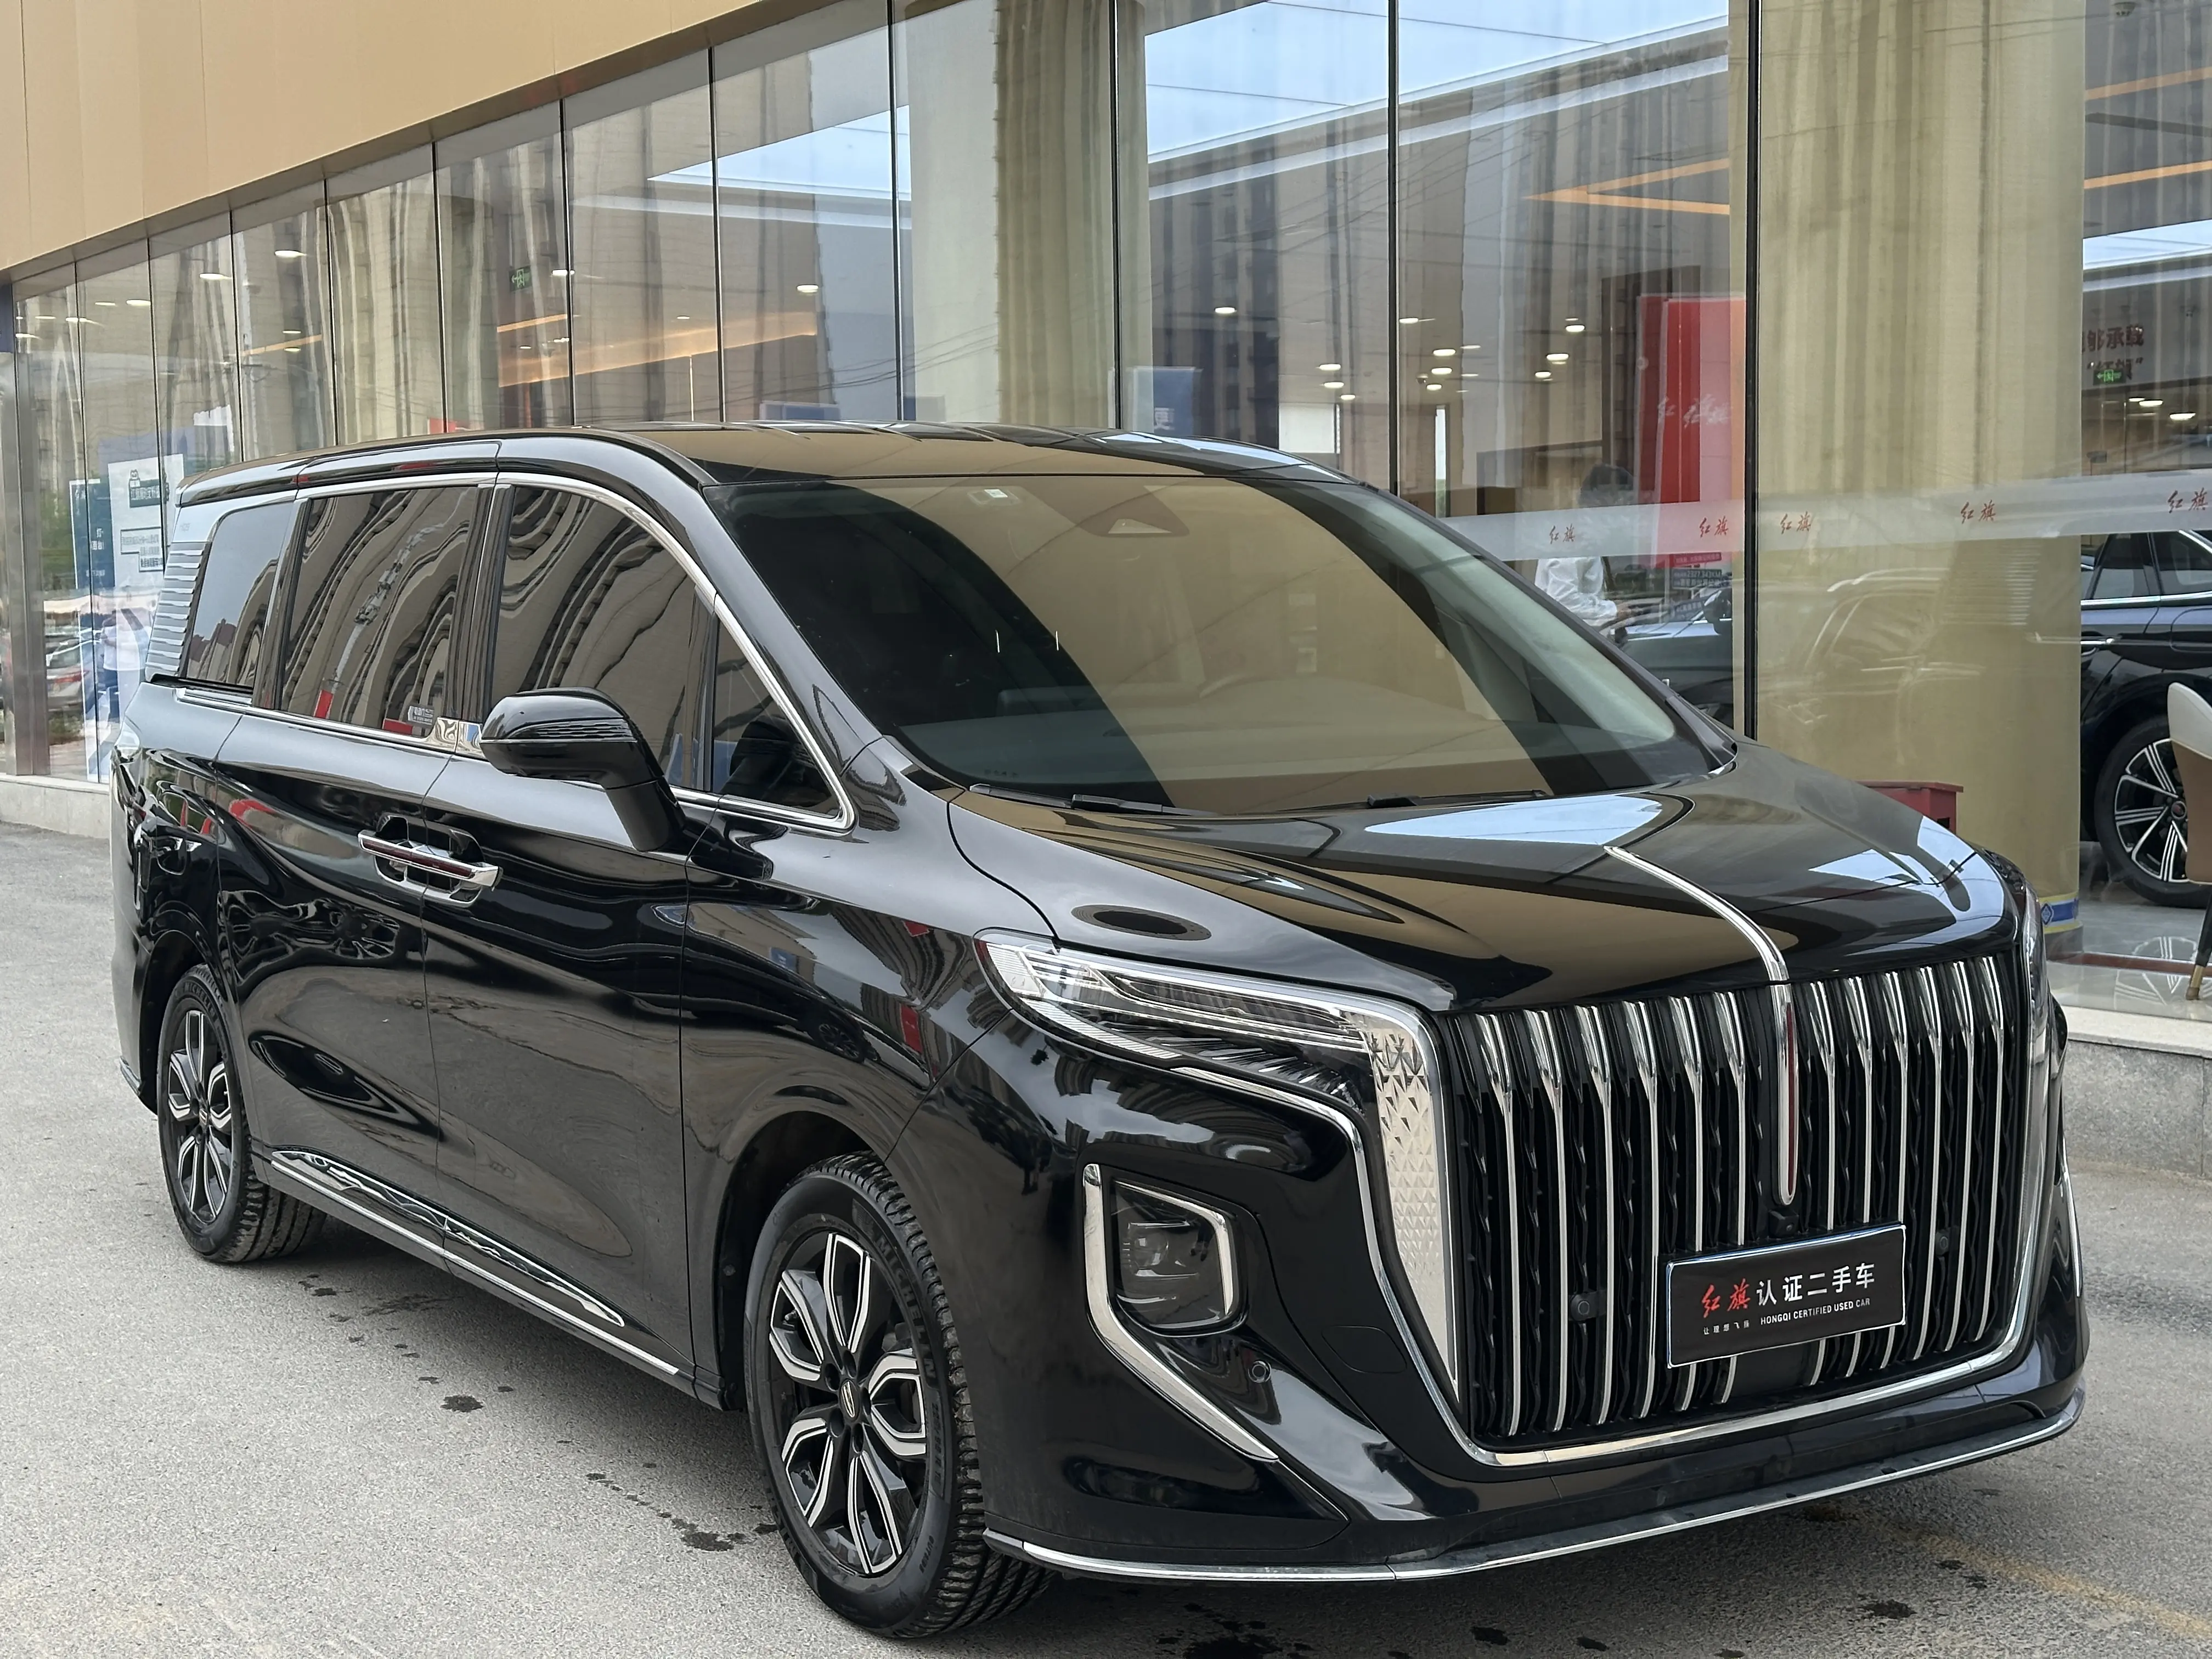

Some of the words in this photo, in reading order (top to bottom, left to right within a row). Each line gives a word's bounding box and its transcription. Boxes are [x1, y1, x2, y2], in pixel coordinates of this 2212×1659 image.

[2082, 324, 2144, 354] 够承载
[1961, 499, 1996, 524] 红旗
[2167, 487, 2210, 514] 红旗
[1549, 524, 1576, 544] 红旗
[1699, 515, 1729, 537] 红旗
[1780, 511, 1812, 535] 红旗
[1702, 1262, 1875, 1318] 红旗认证二手车
[877, 1234, 936, 1379] MICHELIN
[1760, 1312, 1791, 1325] HONGQI
[1793, 1305, 1832, 1319] CERTIFIED
[1834, 1301, 1854, 1312] USED
[1856, 1298, 1870, 1308] CAR
